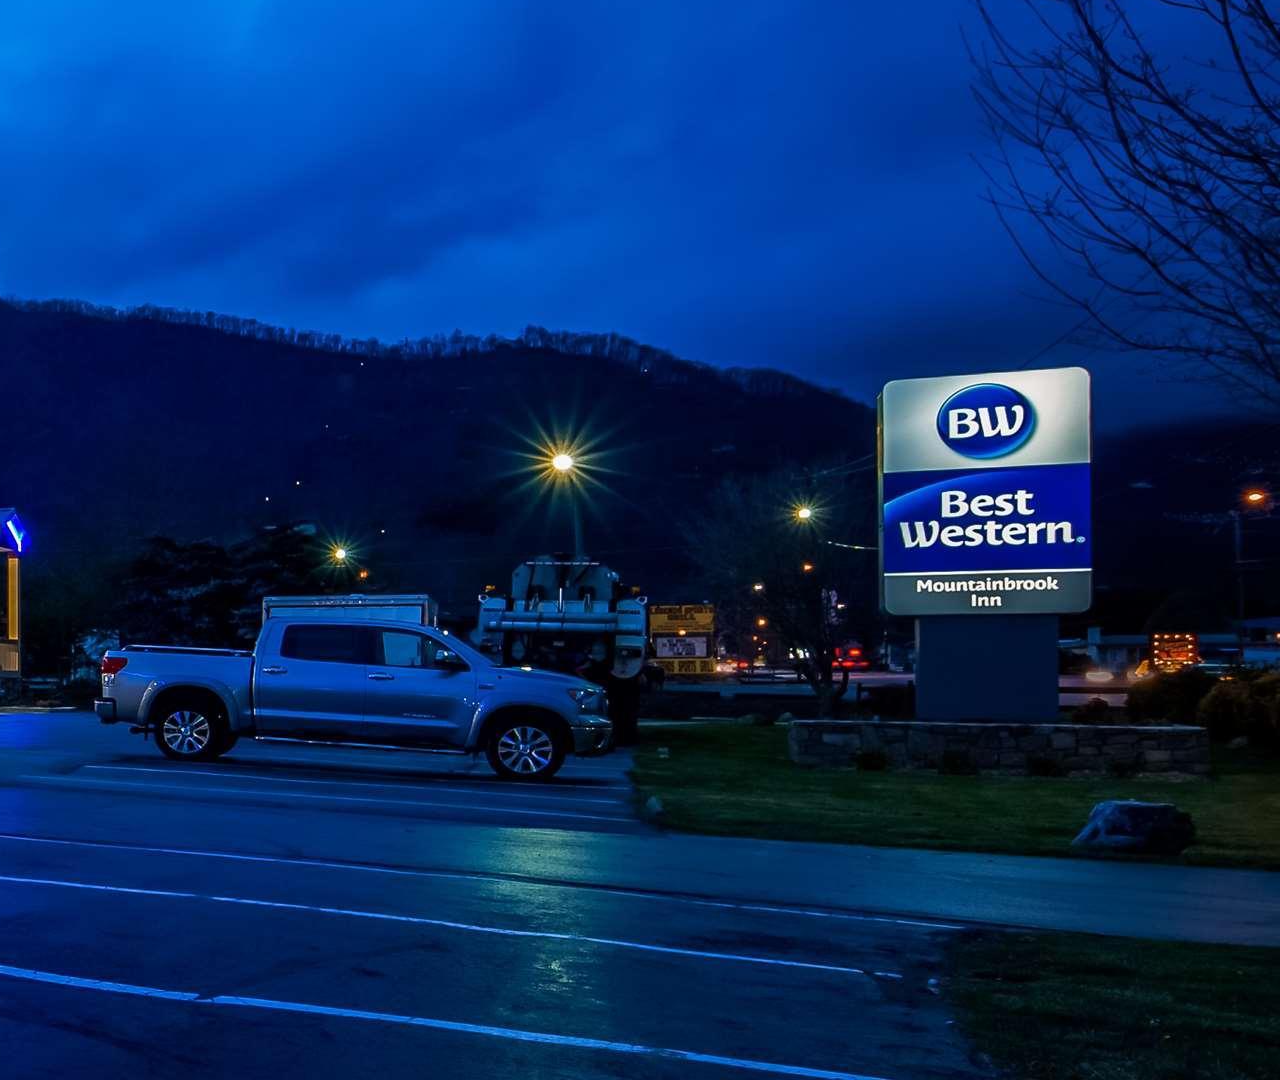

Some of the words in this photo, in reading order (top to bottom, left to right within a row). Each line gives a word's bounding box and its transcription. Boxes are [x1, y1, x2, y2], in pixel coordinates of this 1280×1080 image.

[949, 405, 1025, 439] BW
[941, 490, 1035, 518] Best
[899, 520, 1076, 548] Western
[916, 576, 1059, 593] Mountainbrook
[971, 594, 1002, 607] Inn
